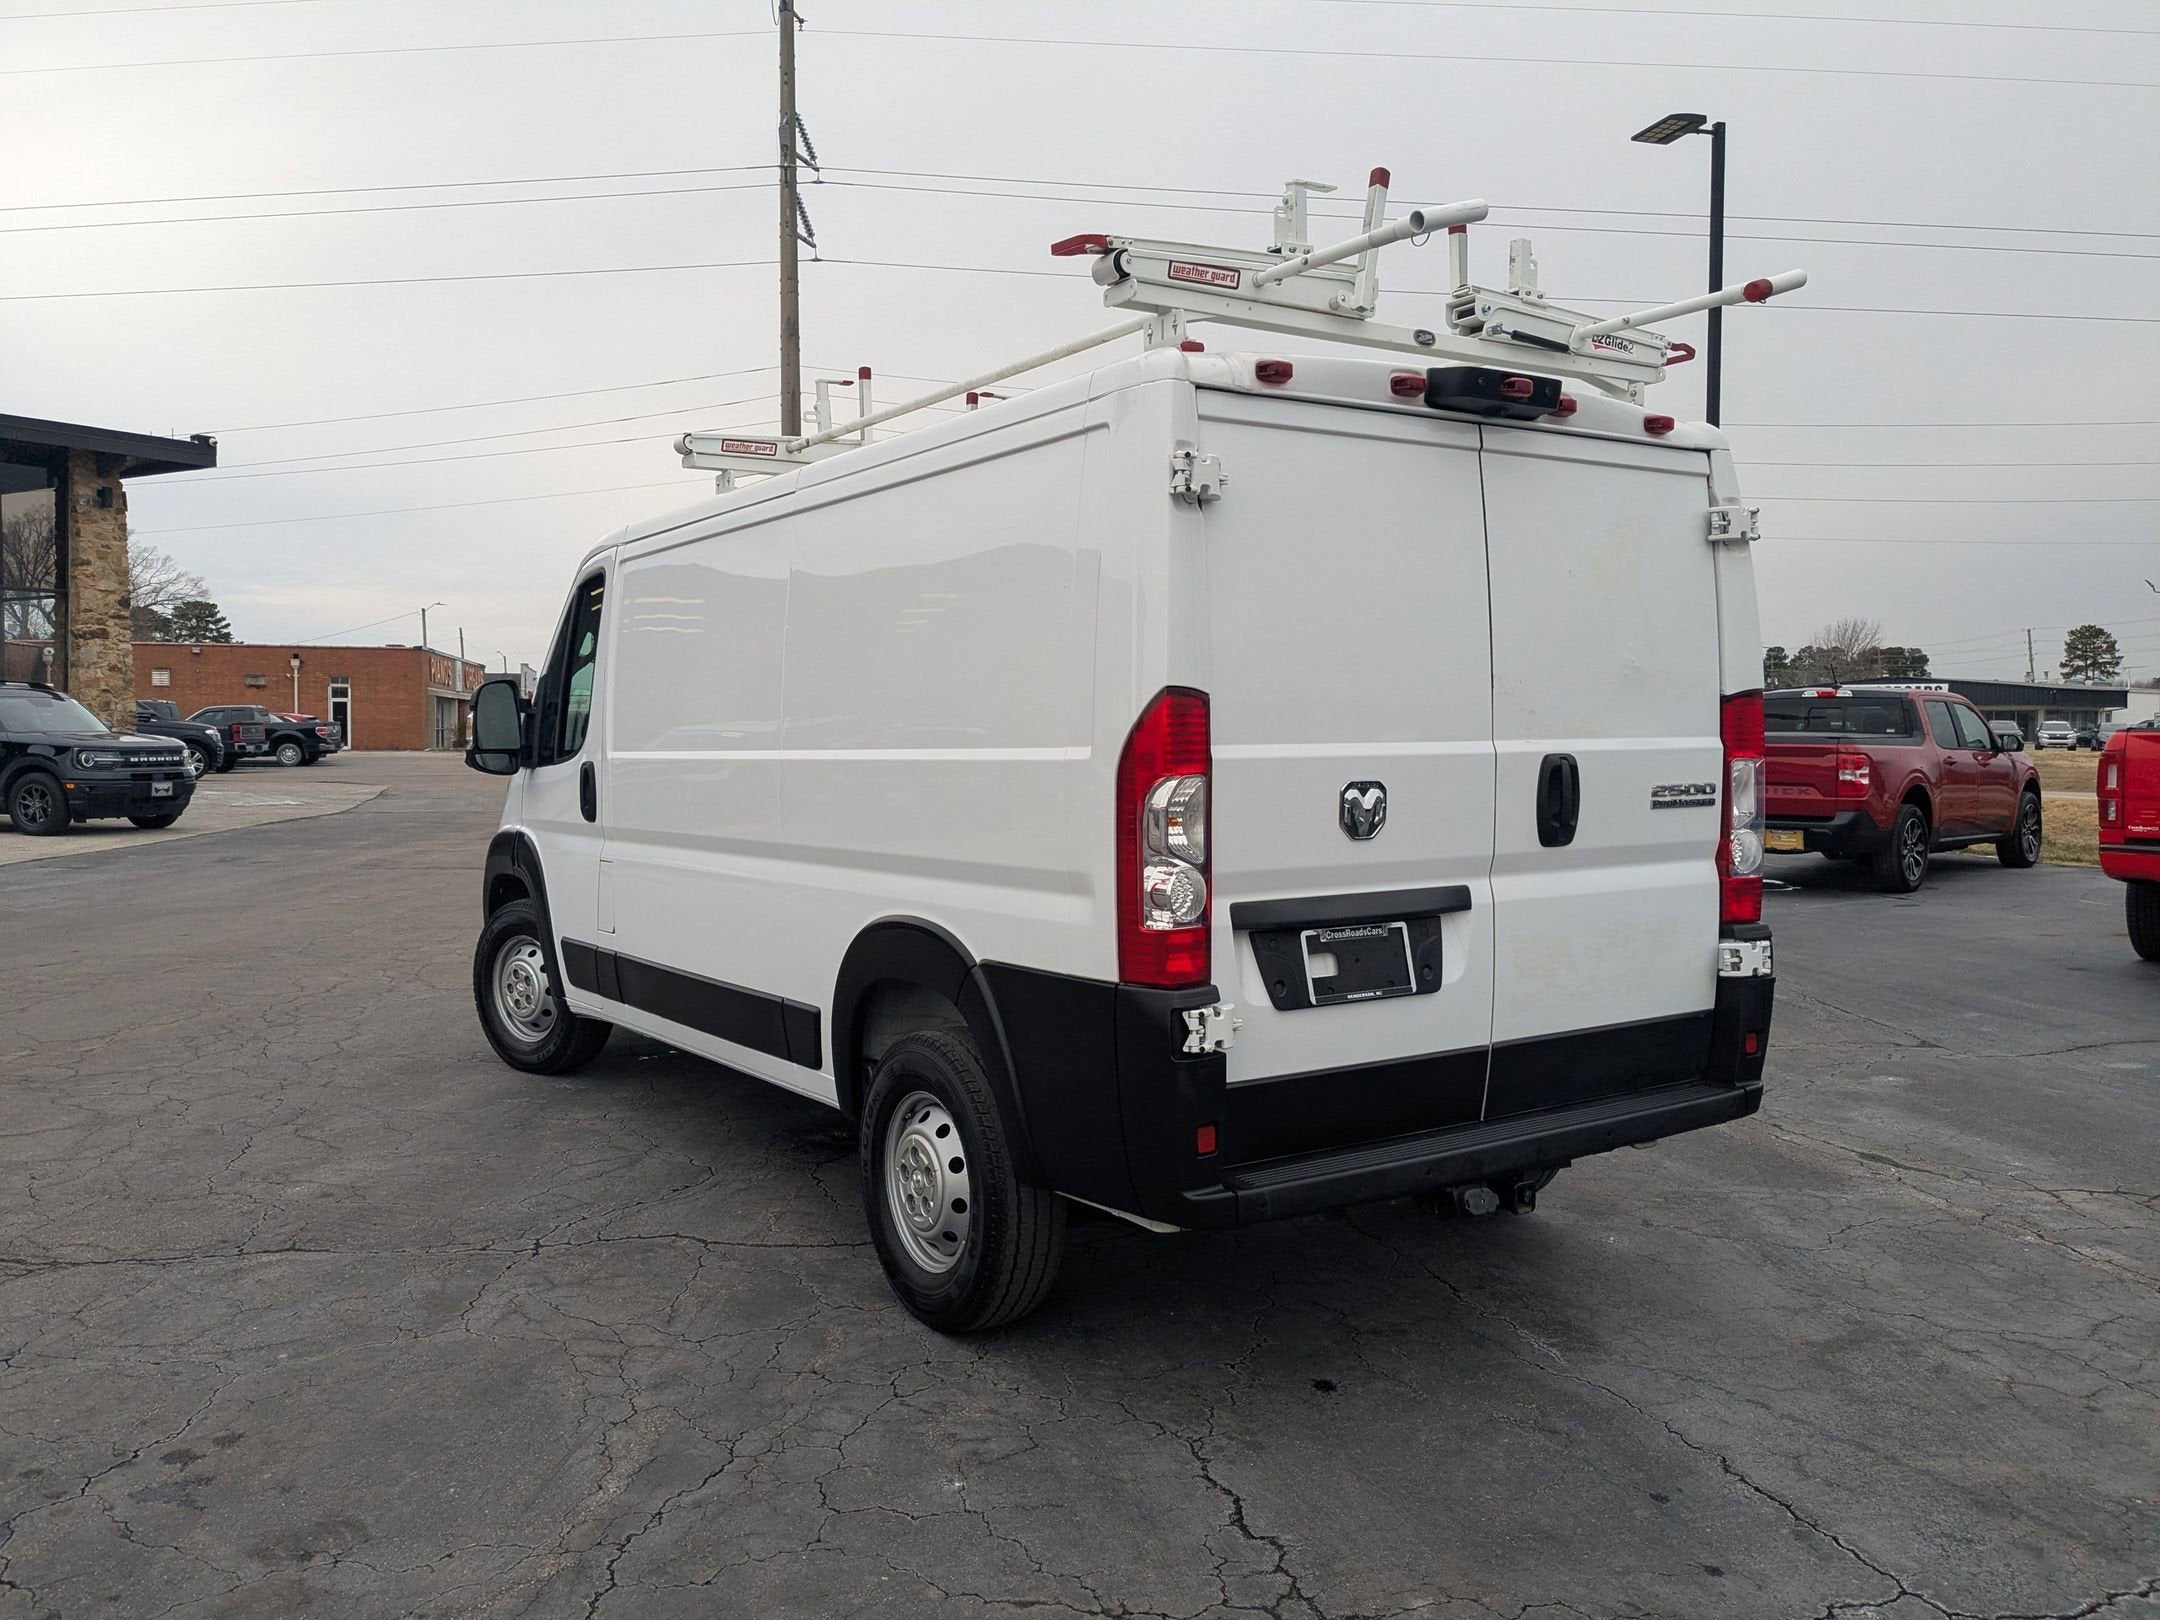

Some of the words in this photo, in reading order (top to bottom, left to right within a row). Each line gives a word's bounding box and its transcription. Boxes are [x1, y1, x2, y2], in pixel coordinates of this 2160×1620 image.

[1172, 264, 1209, 278] weather
[1211, 271, 1236, 283] guard
[725, 442, 753, 450] weather
[1651, 783, 1717, 798] 2500
[1325, 927, 1383, 940] CrossRoadsCars
